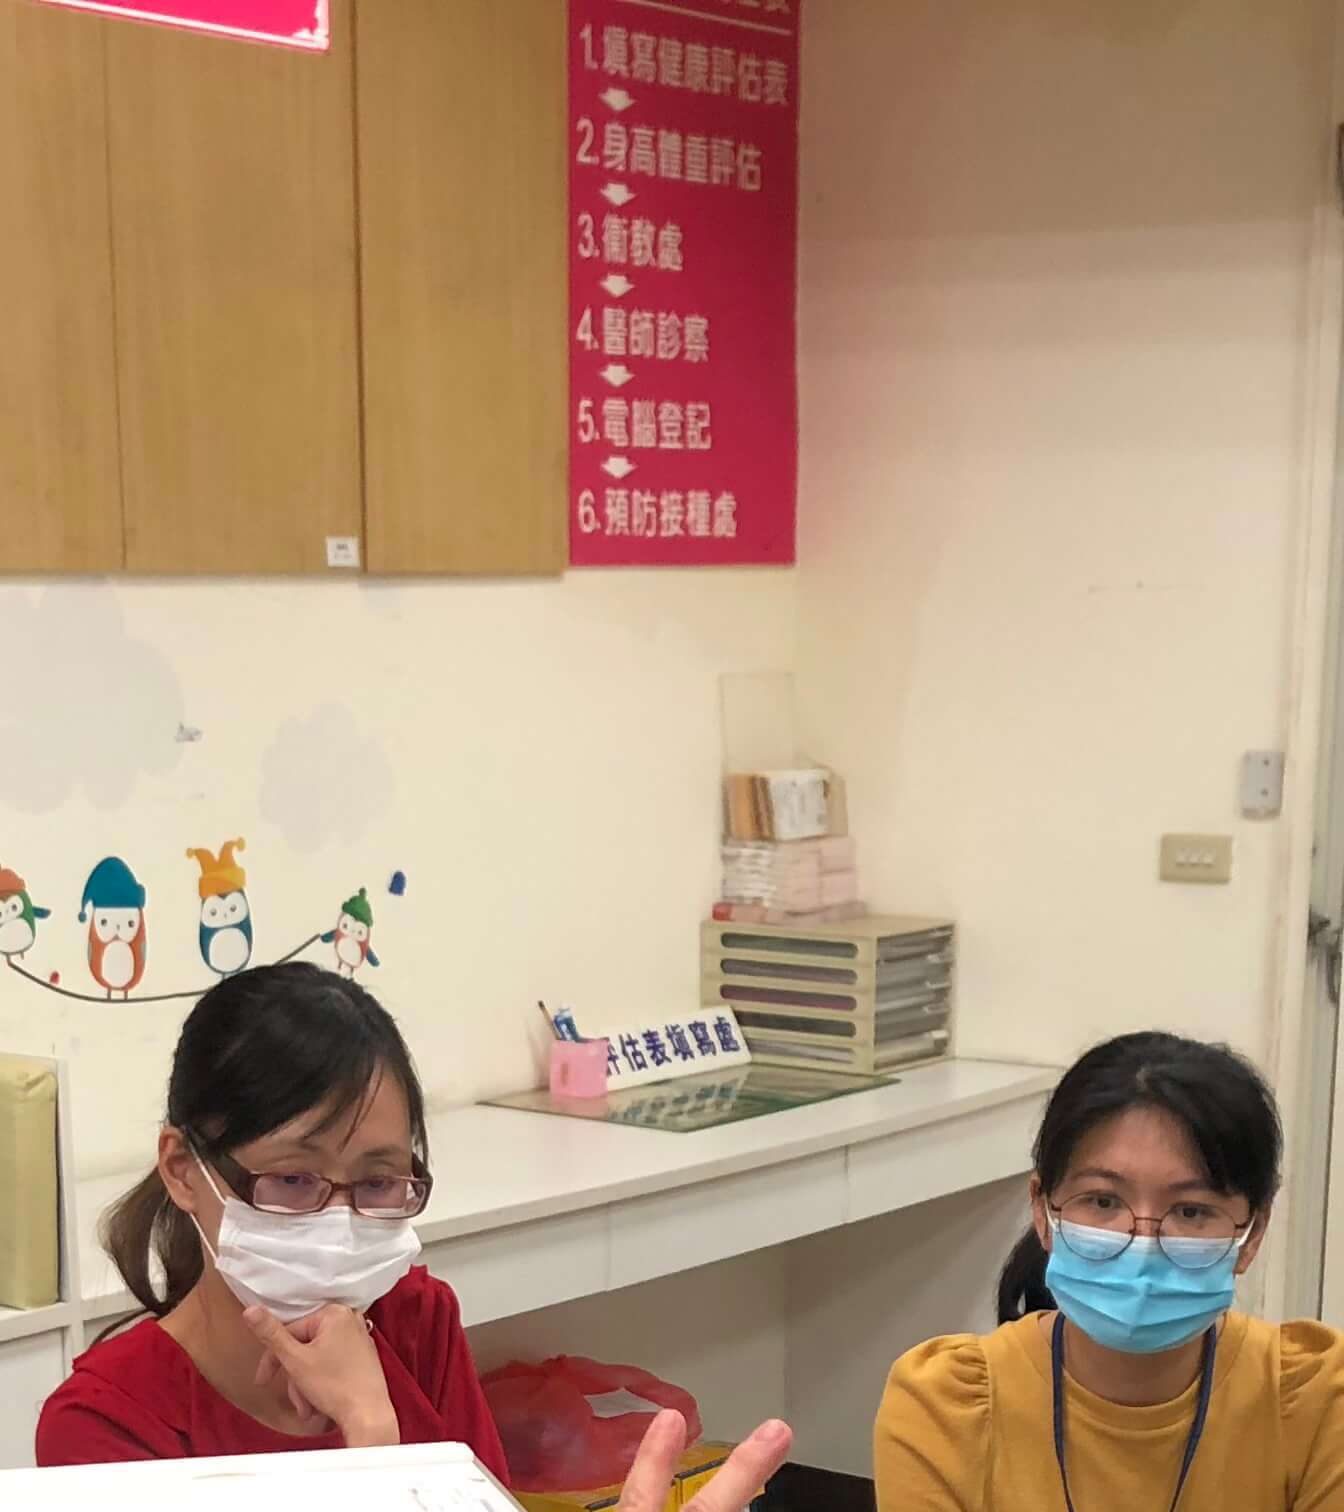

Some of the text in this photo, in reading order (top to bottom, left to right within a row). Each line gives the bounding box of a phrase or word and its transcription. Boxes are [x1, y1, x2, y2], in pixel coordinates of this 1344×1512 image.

[576, 117, 762, 191] 2.身高體重評估
[576, 305, 709, 363] 4.醫師診察
[578, 397, 712, 450] 5.電腦登記
[578, 488, 738, 539] 6.預防接種處
